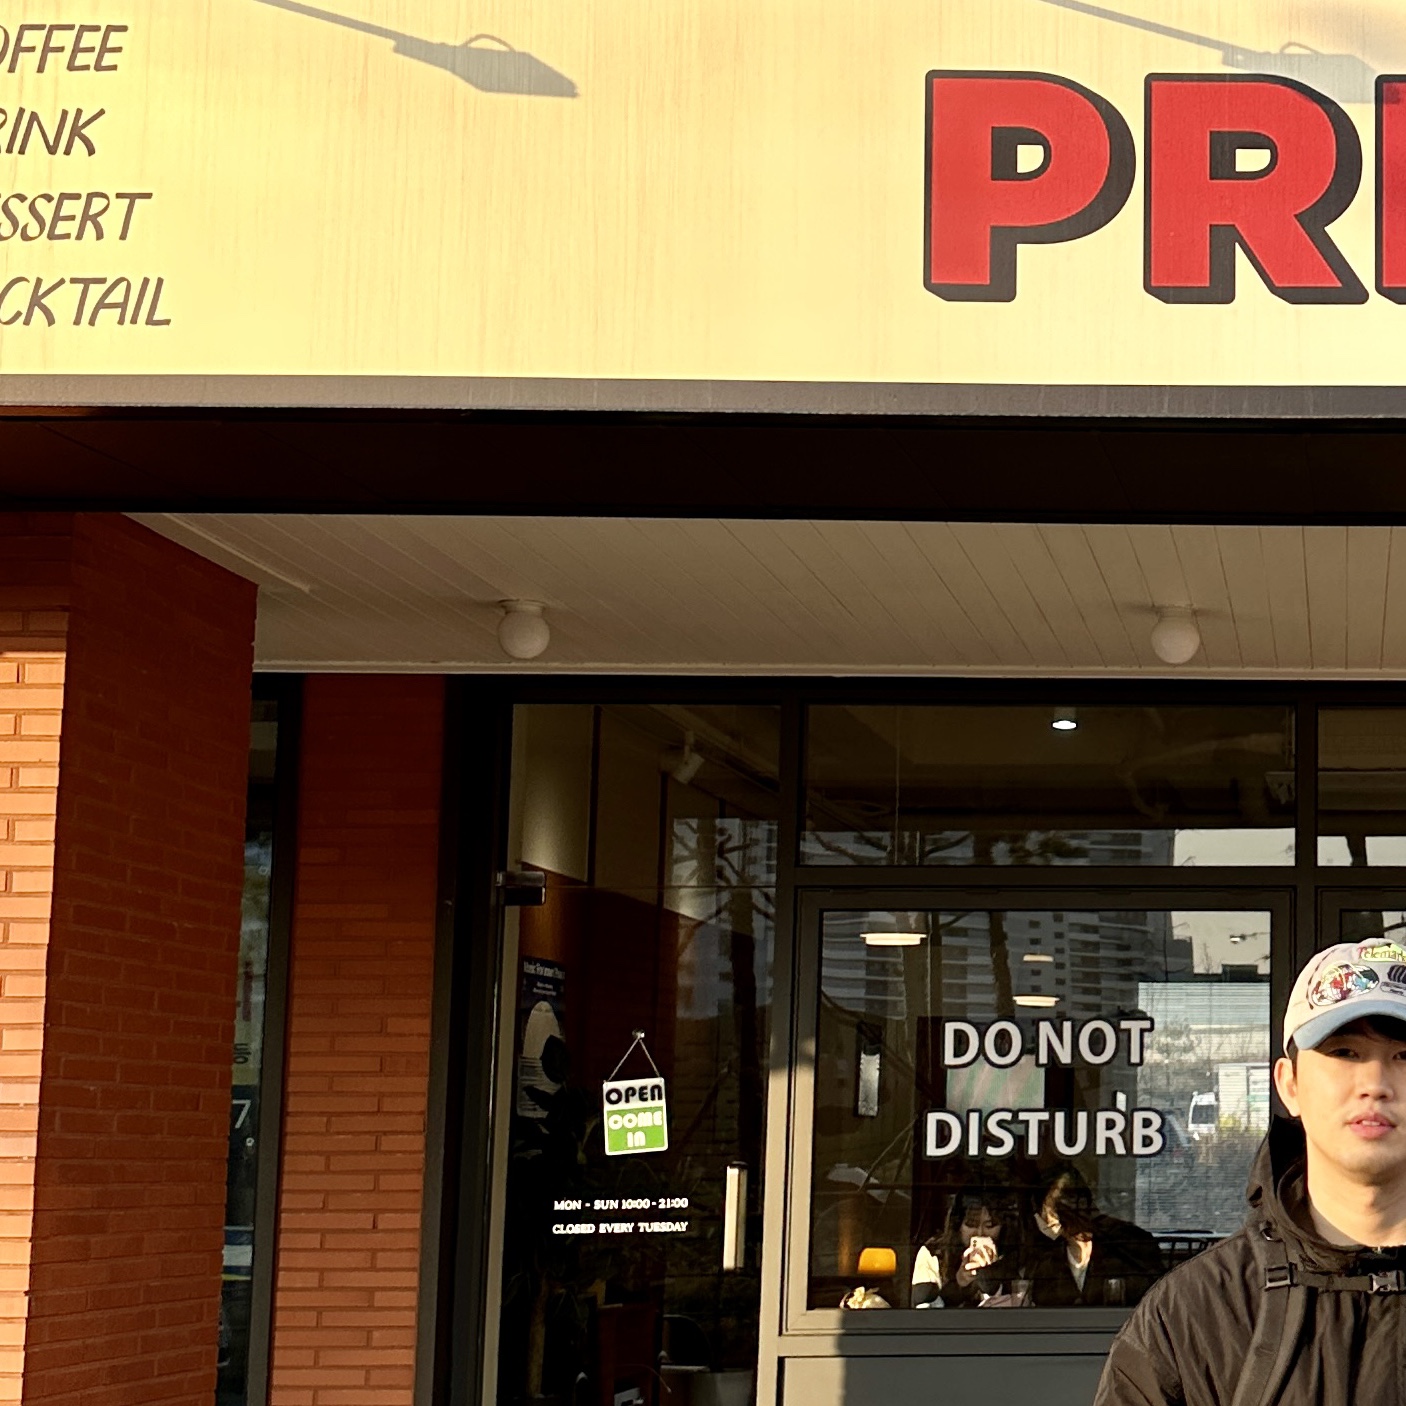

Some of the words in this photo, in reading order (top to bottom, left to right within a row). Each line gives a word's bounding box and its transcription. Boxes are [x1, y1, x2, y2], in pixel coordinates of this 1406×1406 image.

[0, 24, 128, 73] FFEE
[943, 1021, 1023, 1067] DO
[1038, 1019, 1152, 1065] NOT
[605, 1084, 663, 1105] OPEN
[608, 1110, 662, 1130] COME
[627, 1131, 646, 1148] IN
[926, 1110, 1165, 1156] DISTURB
[553, 1199, 582, 1210] MON
[593, 1199, 619, 1210] SUN
[552, 1223, 596, 1234] CLOSED
[599, 1222, 634, 1233] EVERY
[637, 1221, 689, 1232] TUESDAY
